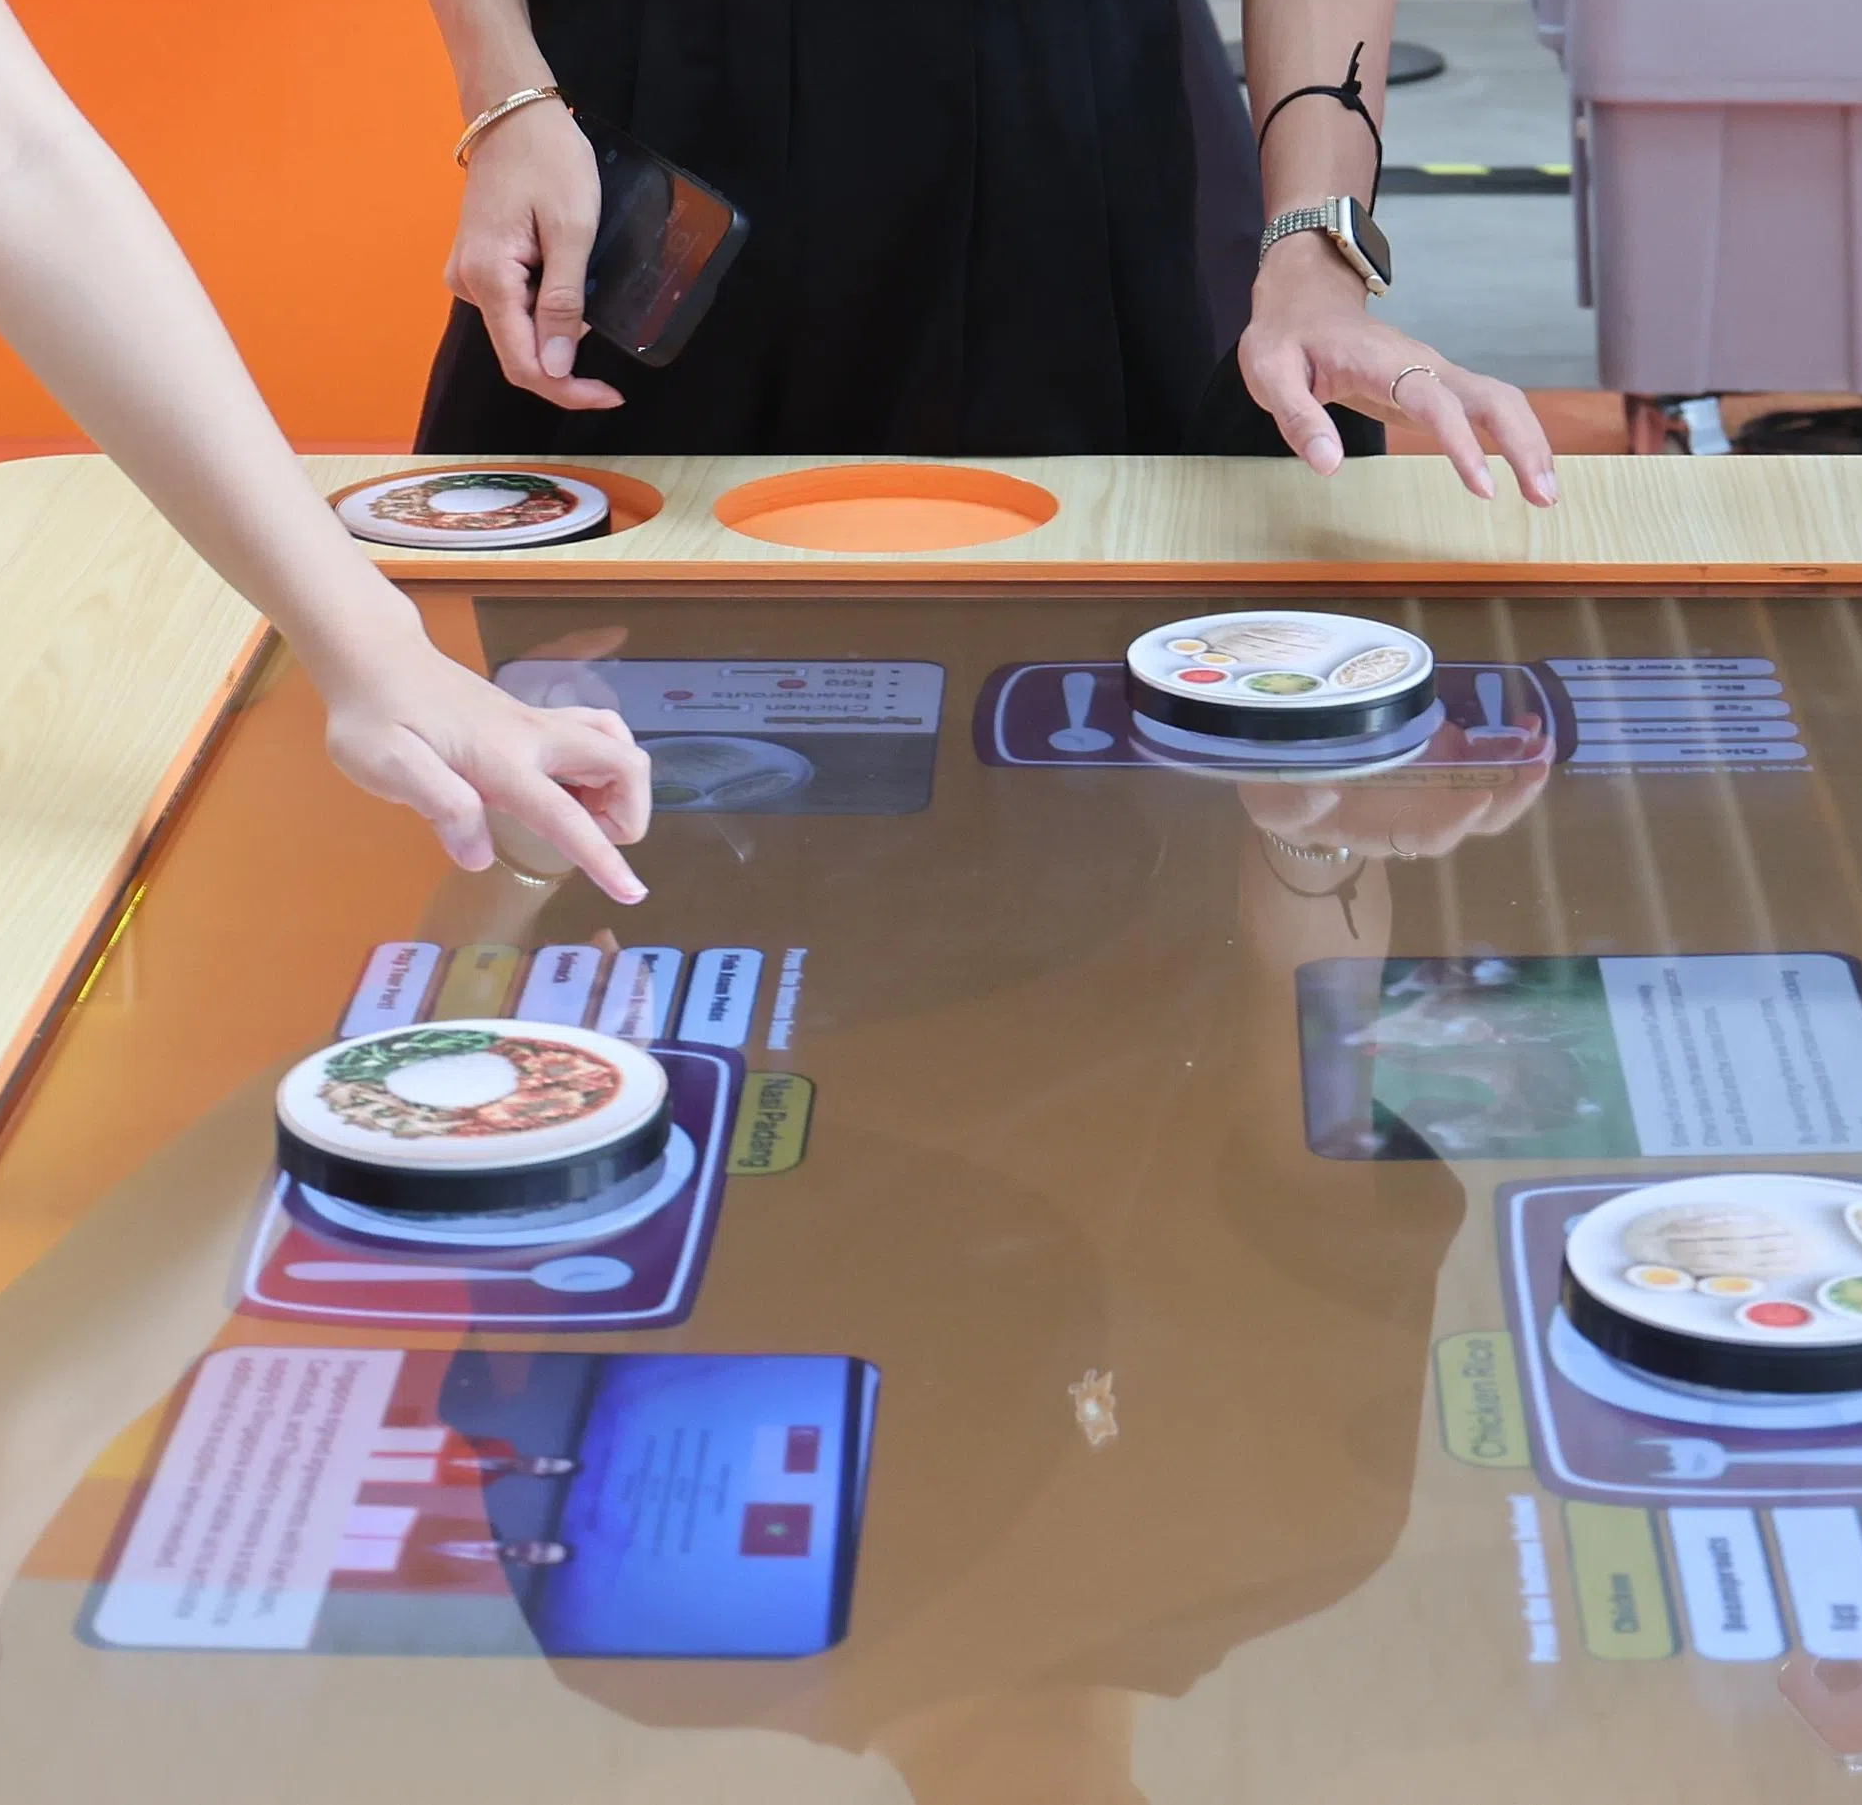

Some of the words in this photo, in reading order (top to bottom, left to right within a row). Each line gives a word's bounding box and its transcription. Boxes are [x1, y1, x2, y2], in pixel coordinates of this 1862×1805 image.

[1692, 663, 1738, 671] Play
[711, 691, 871, 700] Beansprouts
[825, 680, 874, 688] Egg
[765, 704, 868, 713] Chicken
[551, 951, 580, 984] Spinach
[721, 955, 741, 971] Fish
[707, 997, 730, 1024] Pedas
[764, 1078, 792, 1109] Nasi
[743, 1111, 790, 1168] Padang
[1463, 1339, 1497, 1376] Rice
[330, 1360, 366, 1415] Singapore
[1469, 1379, 1507, 1458] Chicken
[233, 1410, 270, 1467] Singapore
[1707, 1536, 1749, 1633] Beansprouts
[1613, 1572, 1639, 1633] Chicken
